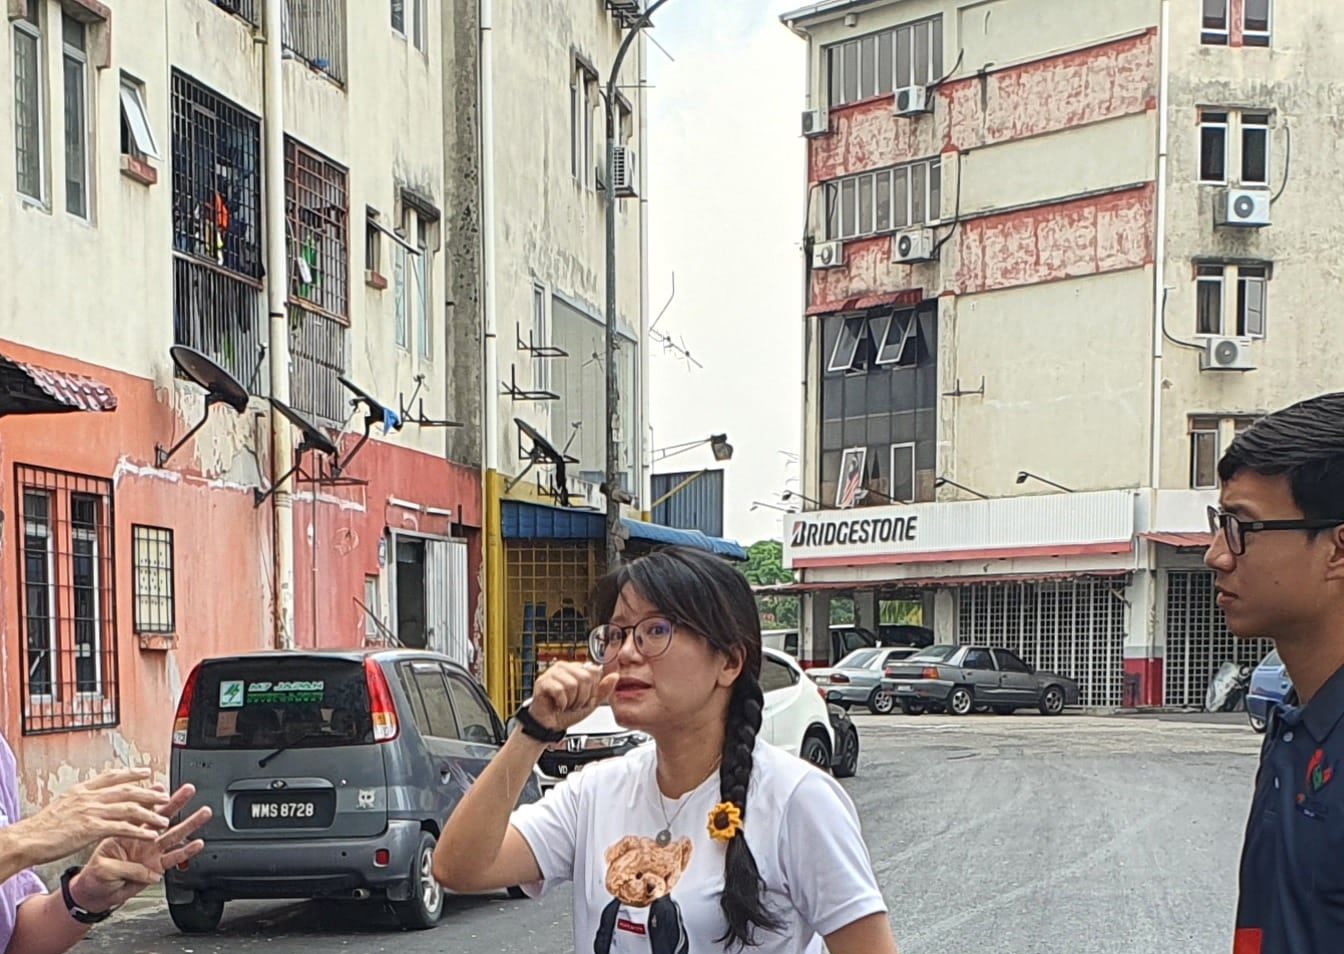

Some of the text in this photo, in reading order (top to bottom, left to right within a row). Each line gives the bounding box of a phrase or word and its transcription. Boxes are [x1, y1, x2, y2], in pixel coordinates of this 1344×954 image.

[790, 515, 918, 548] BRIDGESTONE
[251, 802, 315, 818] WMS 8728
